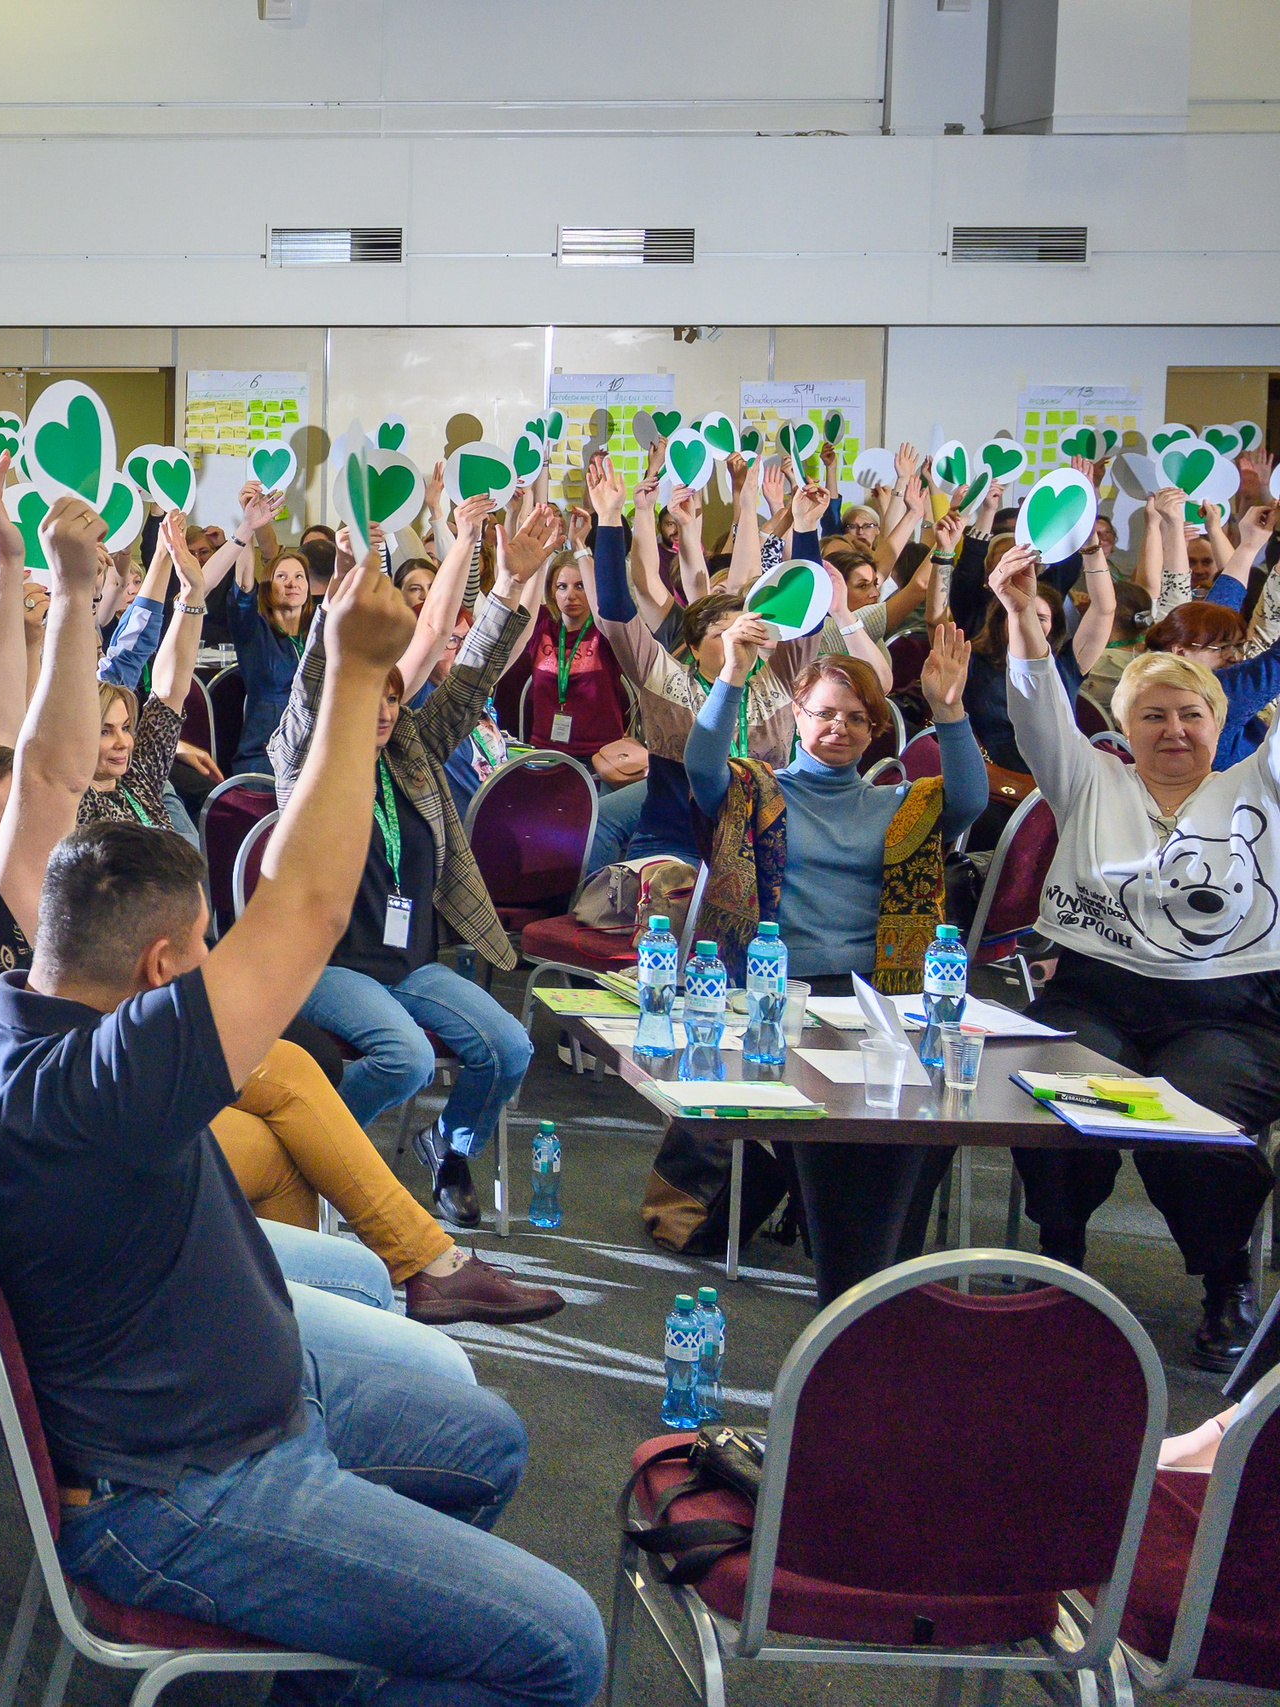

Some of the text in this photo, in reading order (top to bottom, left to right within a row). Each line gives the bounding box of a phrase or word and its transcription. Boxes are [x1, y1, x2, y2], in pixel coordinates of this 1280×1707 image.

[249, 374, 262, 389] 6
[607, 377, 625, 392] 10
[1077, 386, 1095, 398] 13
[1080, 916, 1133, 949] POOH
